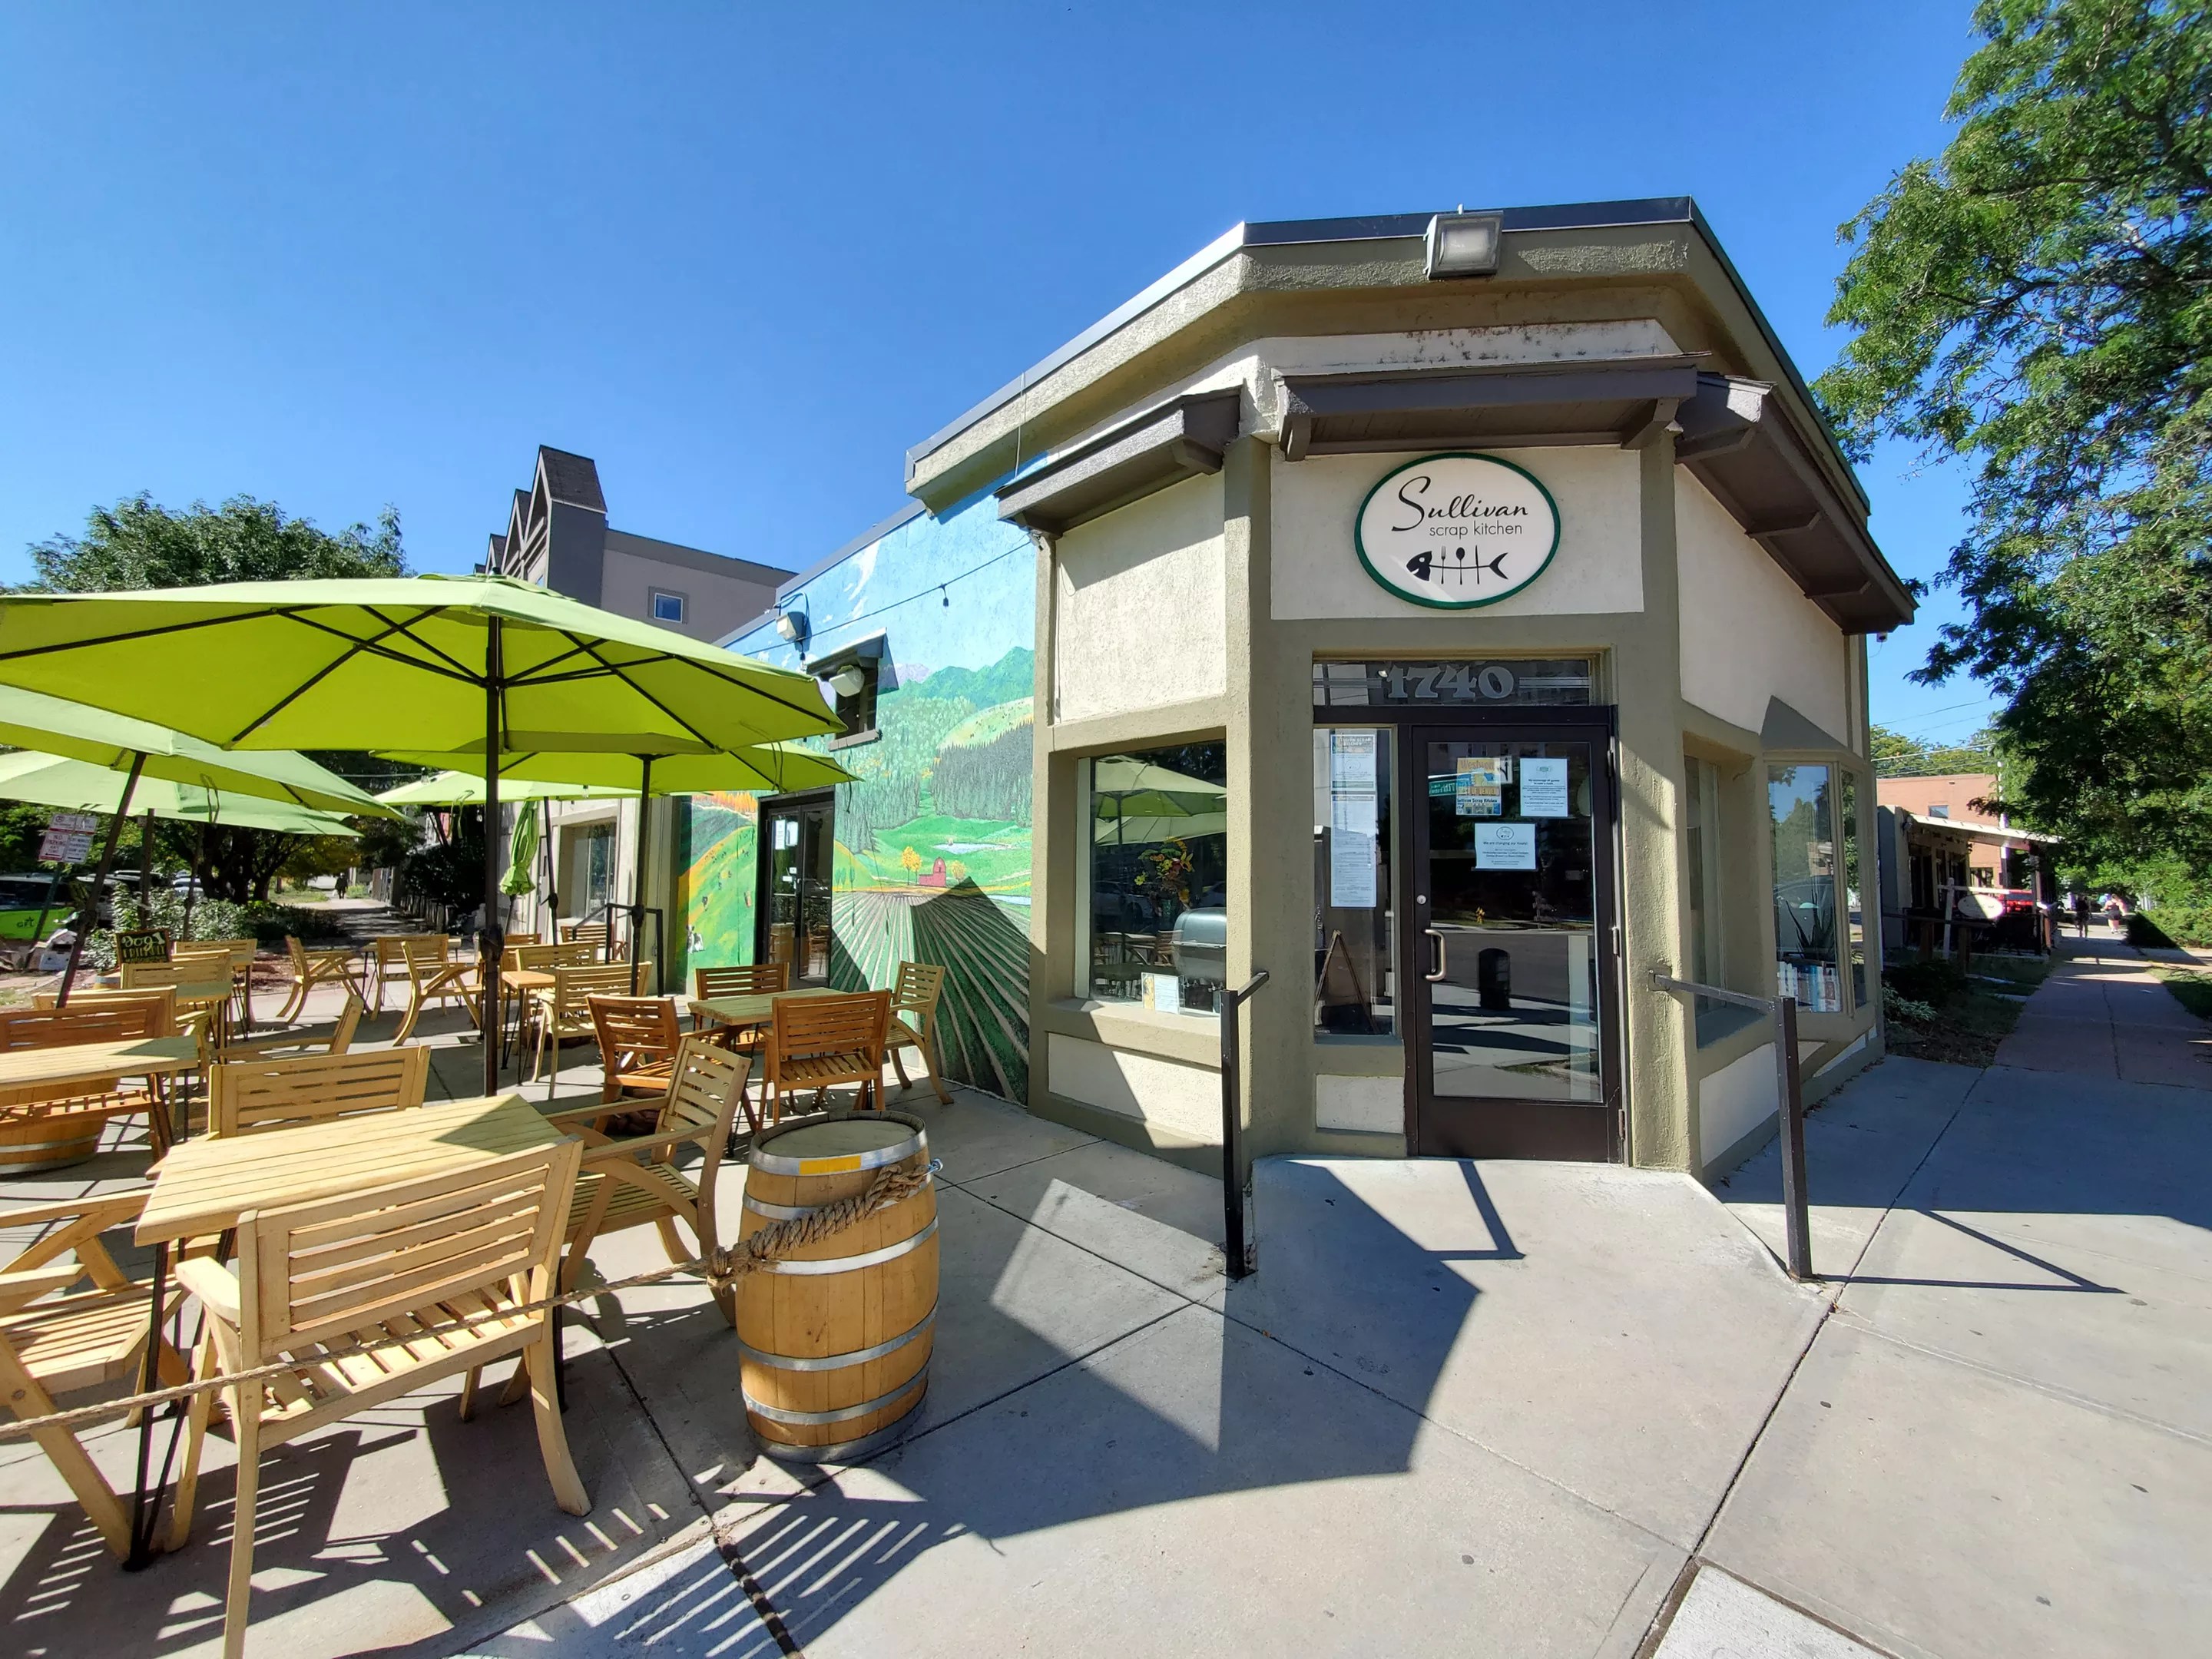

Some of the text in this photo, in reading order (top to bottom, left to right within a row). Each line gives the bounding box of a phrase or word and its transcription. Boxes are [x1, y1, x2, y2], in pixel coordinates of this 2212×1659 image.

[1391, 476, 1528, 531] Sullivan
[1429, 520, 1523, 539] scrap kitchen
[1386, 665, 1514, 699] 1740
